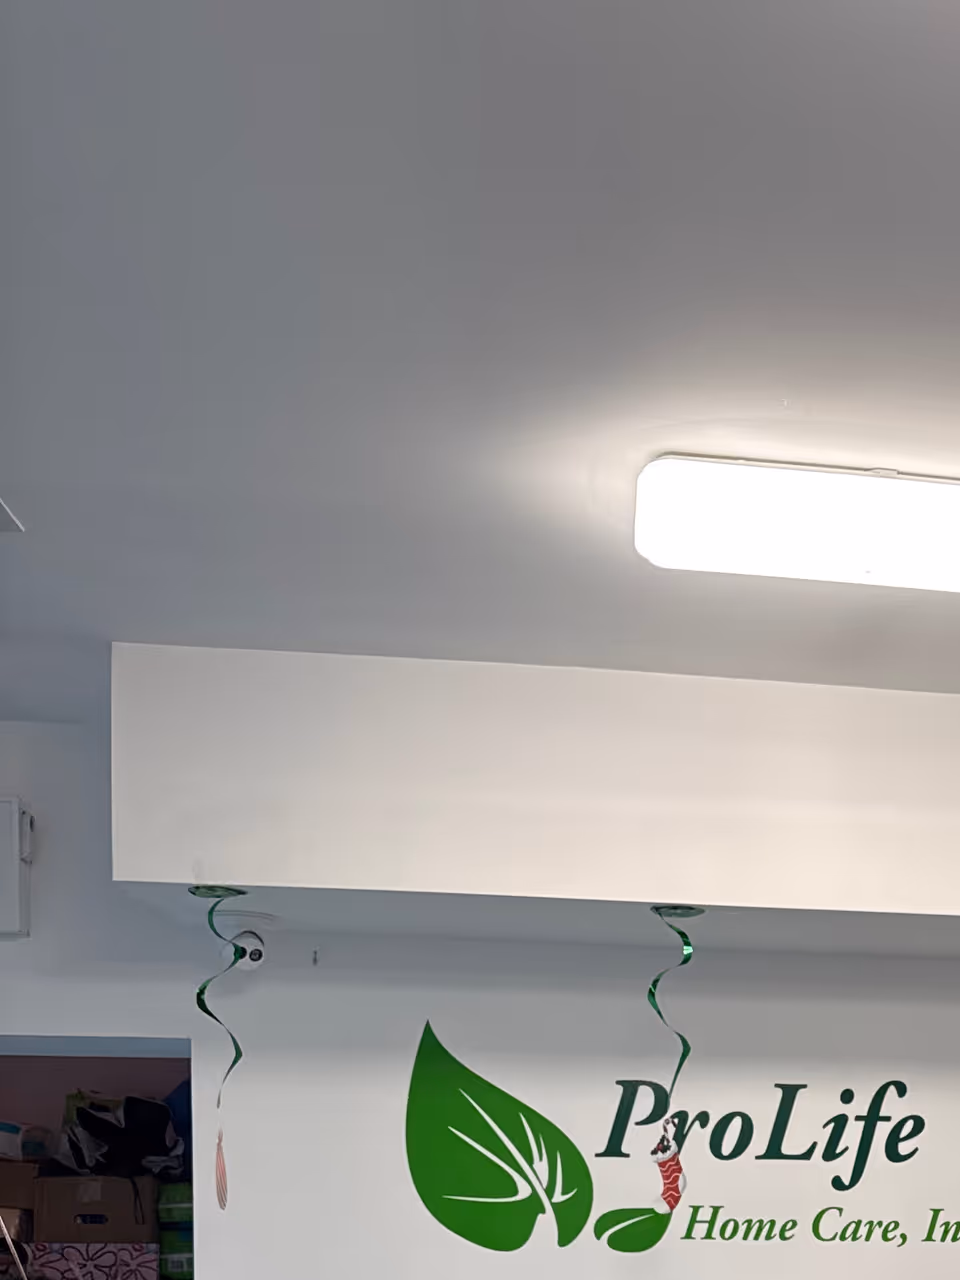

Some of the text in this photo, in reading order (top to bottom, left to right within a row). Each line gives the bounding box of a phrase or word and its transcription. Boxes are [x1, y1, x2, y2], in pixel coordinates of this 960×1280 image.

[594, 1079, 926, 1192] ProLife
[681, 1204, 798, 1243] Home
[811, 1206, 910, 1247] Care,
